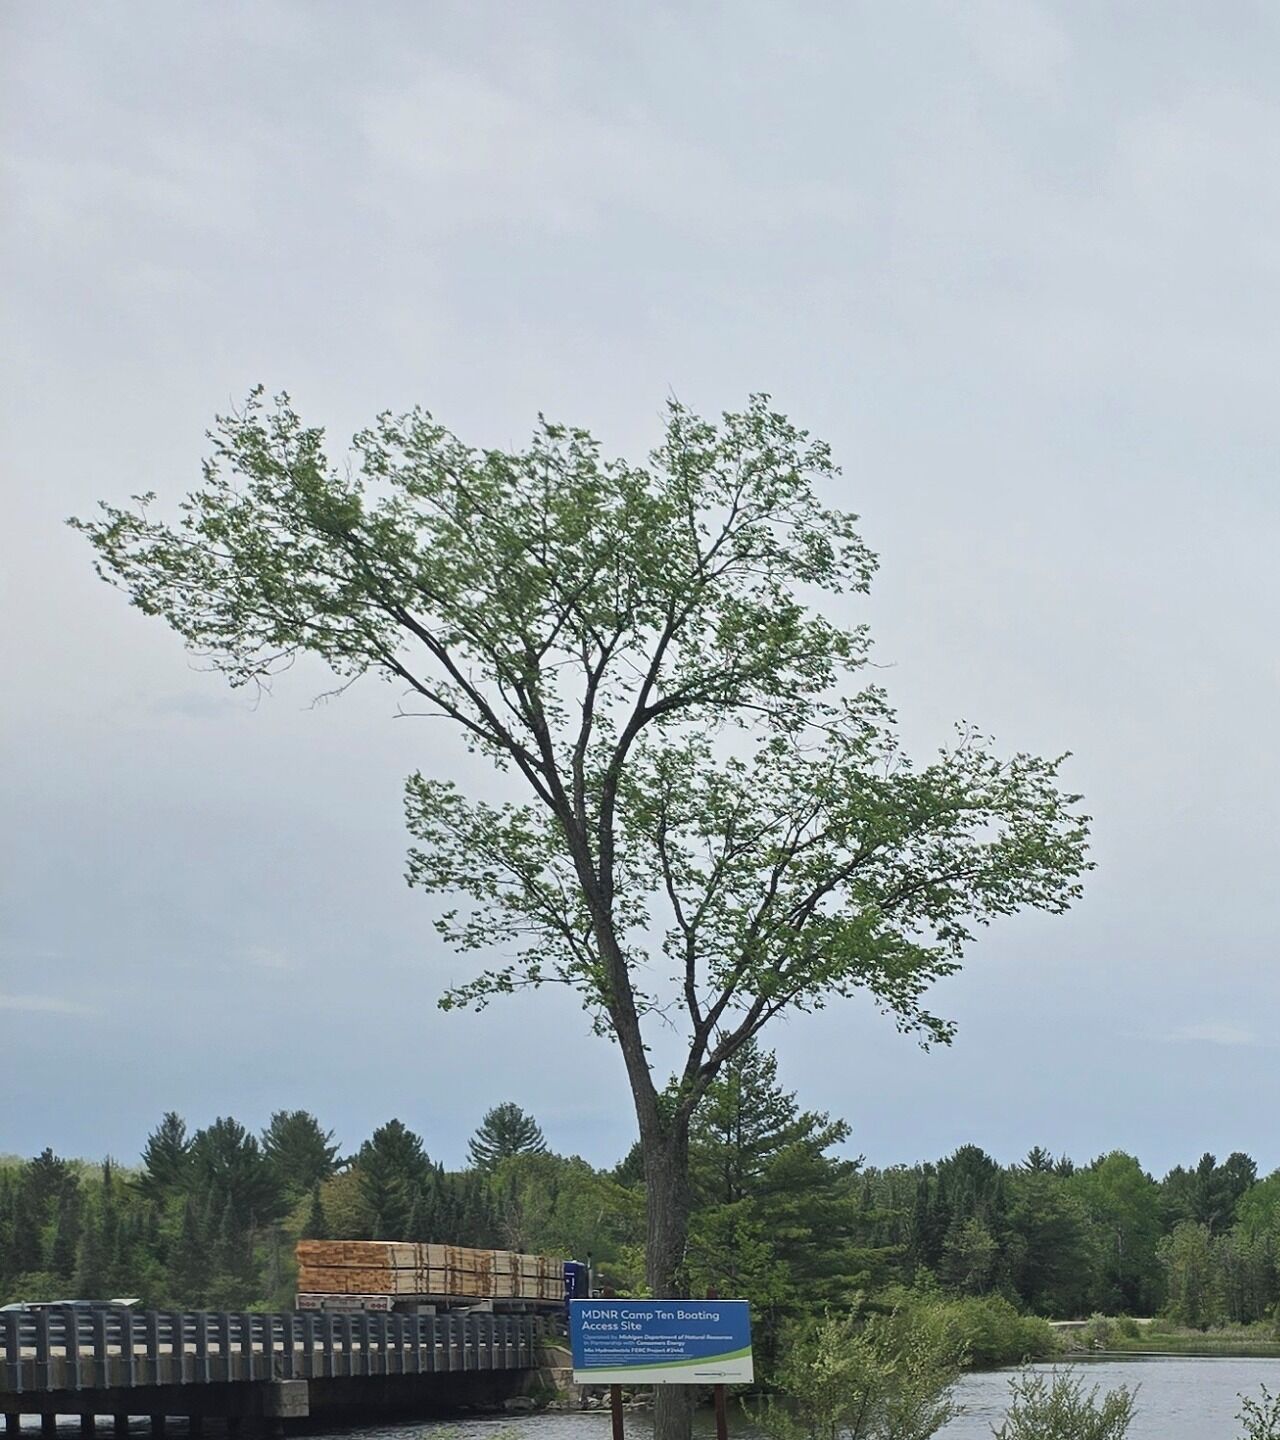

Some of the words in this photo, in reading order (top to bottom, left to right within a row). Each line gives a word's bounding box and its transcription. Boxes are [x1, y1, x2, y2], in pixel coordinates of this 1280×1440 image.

[582, 1310, 618, 1319] MDNR
[621, 1310, 653, 1321] Camp
[655, 1310, 674, 1319] Ten
[677, 1310, 720, 1322] Boating
[582, 1321, 619, 1330] Access
[621, 1321, 642, 1330] Site
